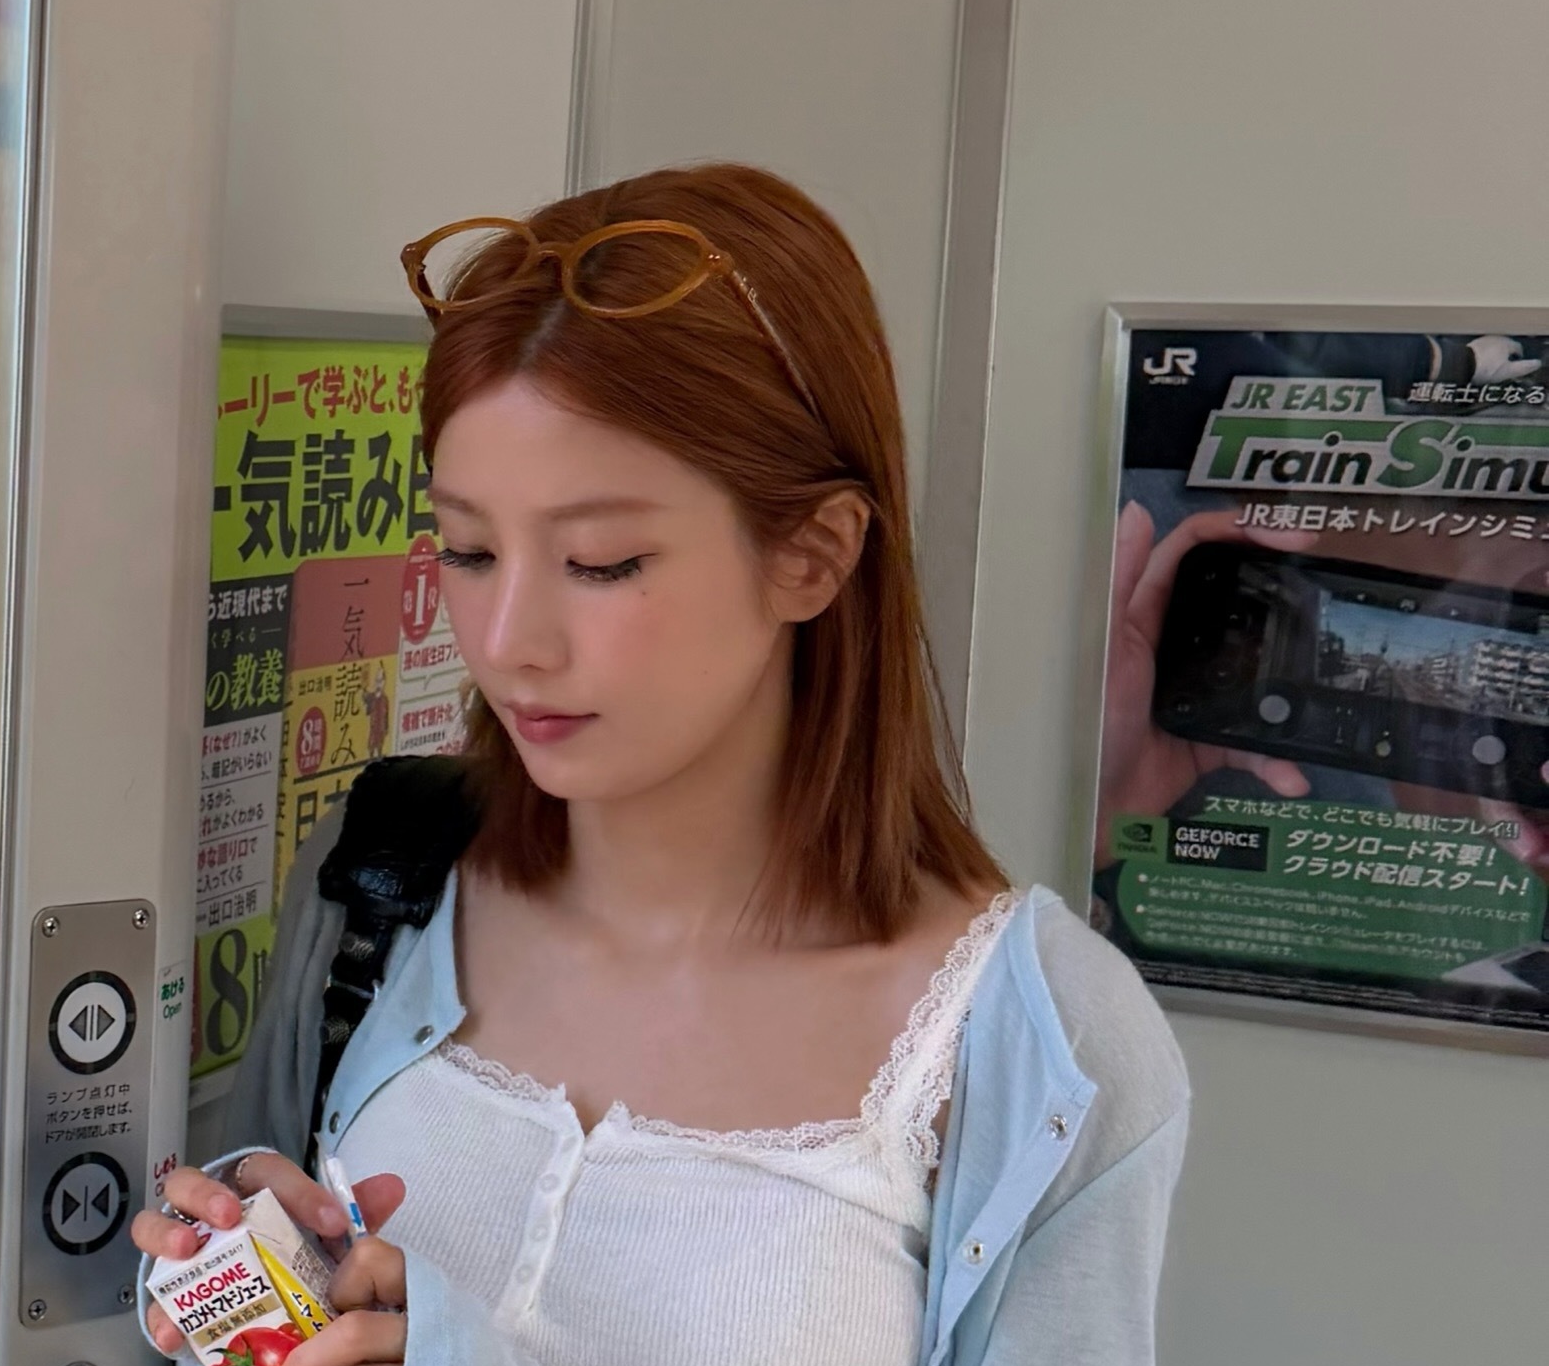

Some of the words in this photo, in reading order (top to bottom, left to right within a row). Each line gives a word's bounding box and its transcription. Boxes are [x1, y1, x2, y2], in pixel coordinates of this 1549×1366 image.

[1143, 347, 1197, 376] JR
[1230, 383, 1275, 409] JR
[1282, 384, 1376, 412] EAST
[1207, 416, 1386, 486] Train
[206, 648, 284, 712] の教養
[1174, 826, 1261, 849] GEFORCE
[1286, 829, 1497, 867] ダウンロード不要!
[1174, 844, 1220, 861] NOW
[1283, 855, 1530, 897] クラウド配信スタート!
[161, 977, 184, 1001] あける
[163, 1002, 182, 1020] Open
[46, 1101, 132, 1123] ボタンを押せば、
[174, 1262, 251, 1312] KAGOME
[179, 1275, 272, 1333] カゴメトマトジュース
